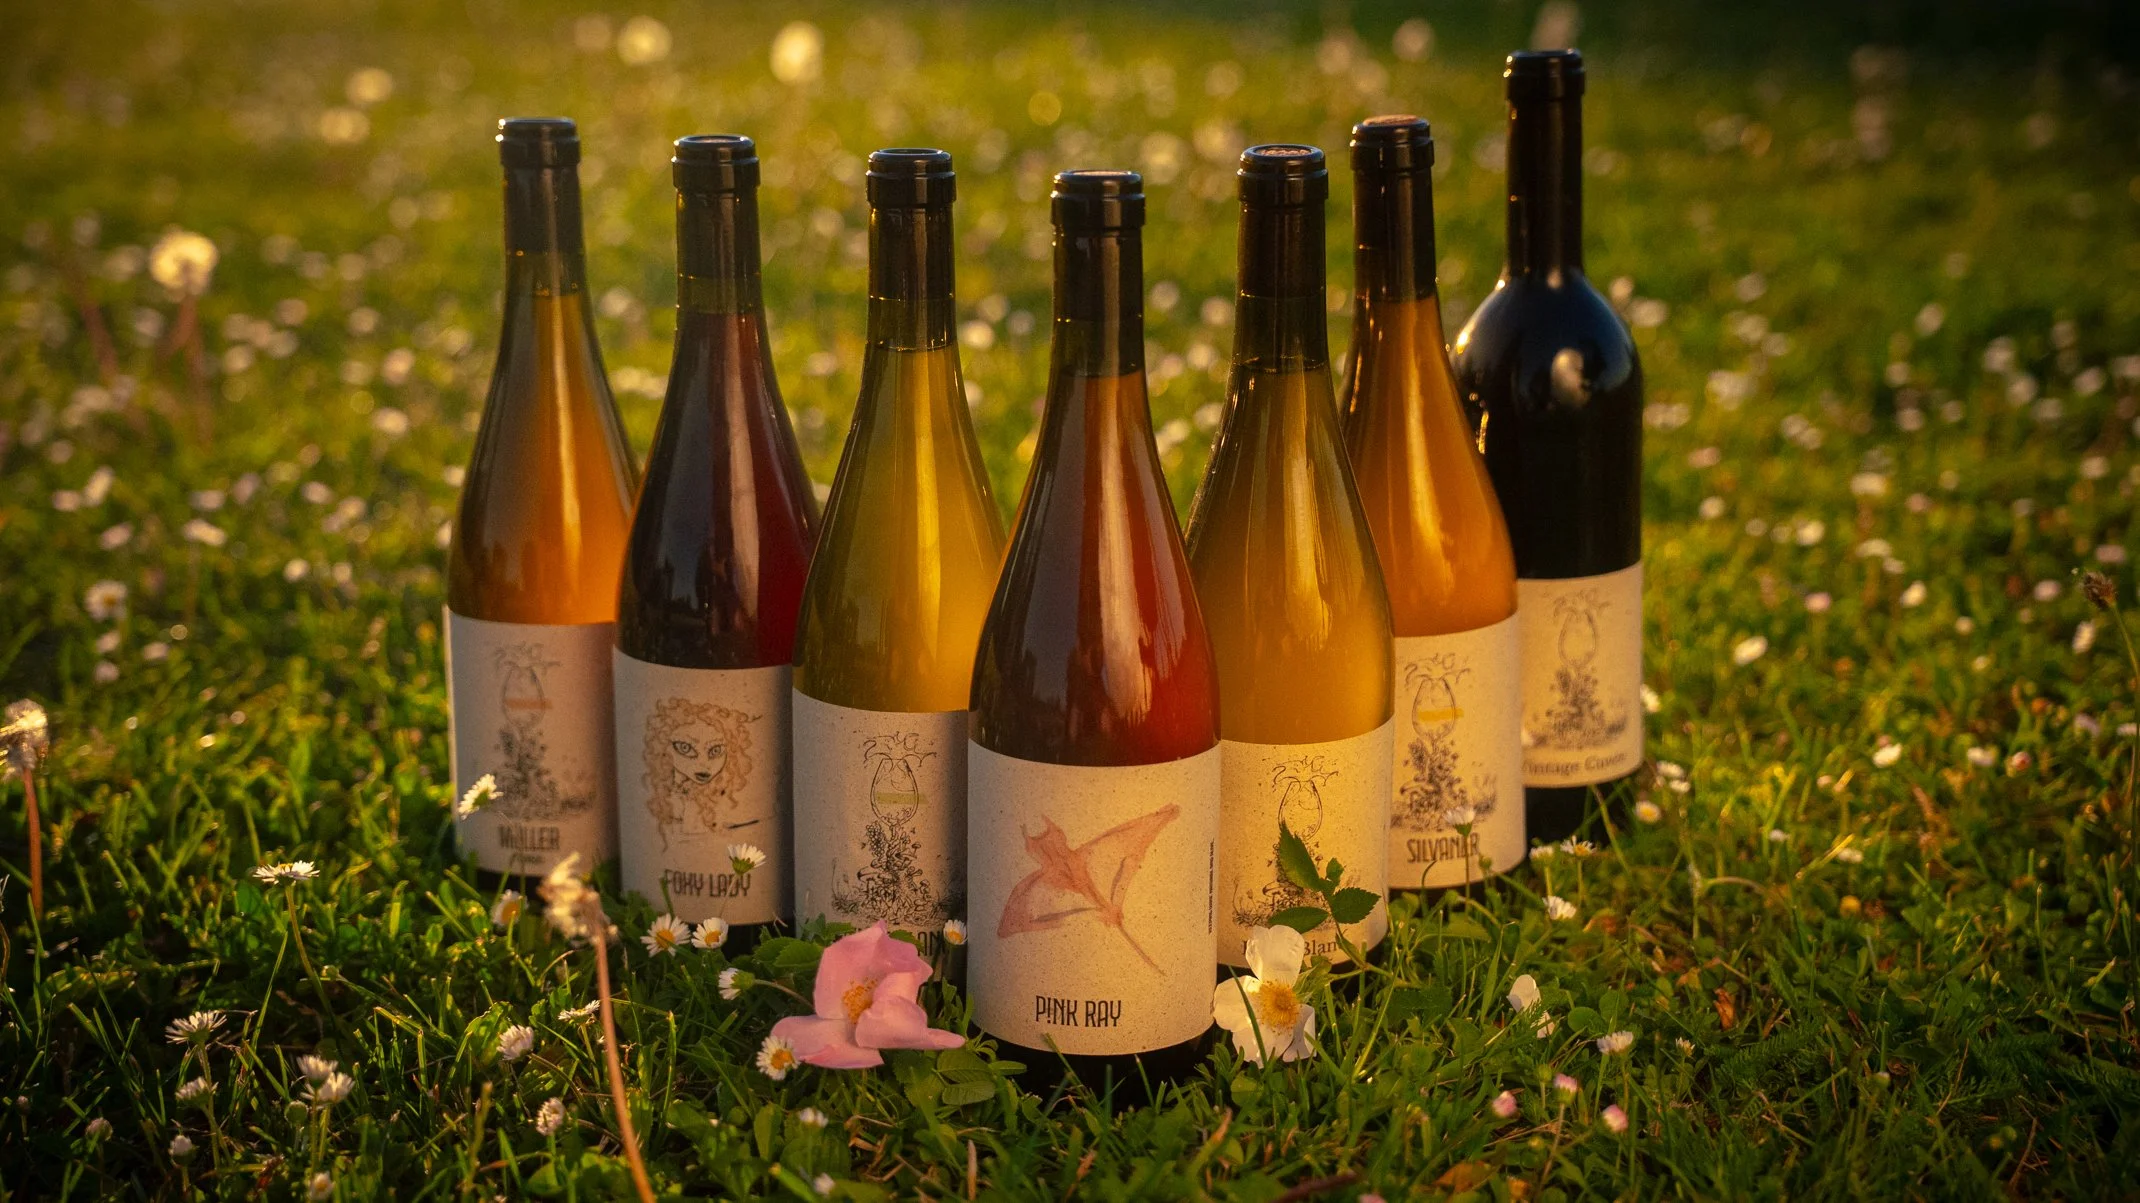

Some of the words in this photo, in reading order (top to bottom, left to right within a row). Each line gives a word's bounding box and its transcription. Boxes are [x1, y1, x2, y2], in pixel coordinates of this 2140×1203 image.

[709, 873, 752, 897] LADY
[1304, 939, 1338, 955] Blan
[1085, 1000, 1122, 1028] RAY
